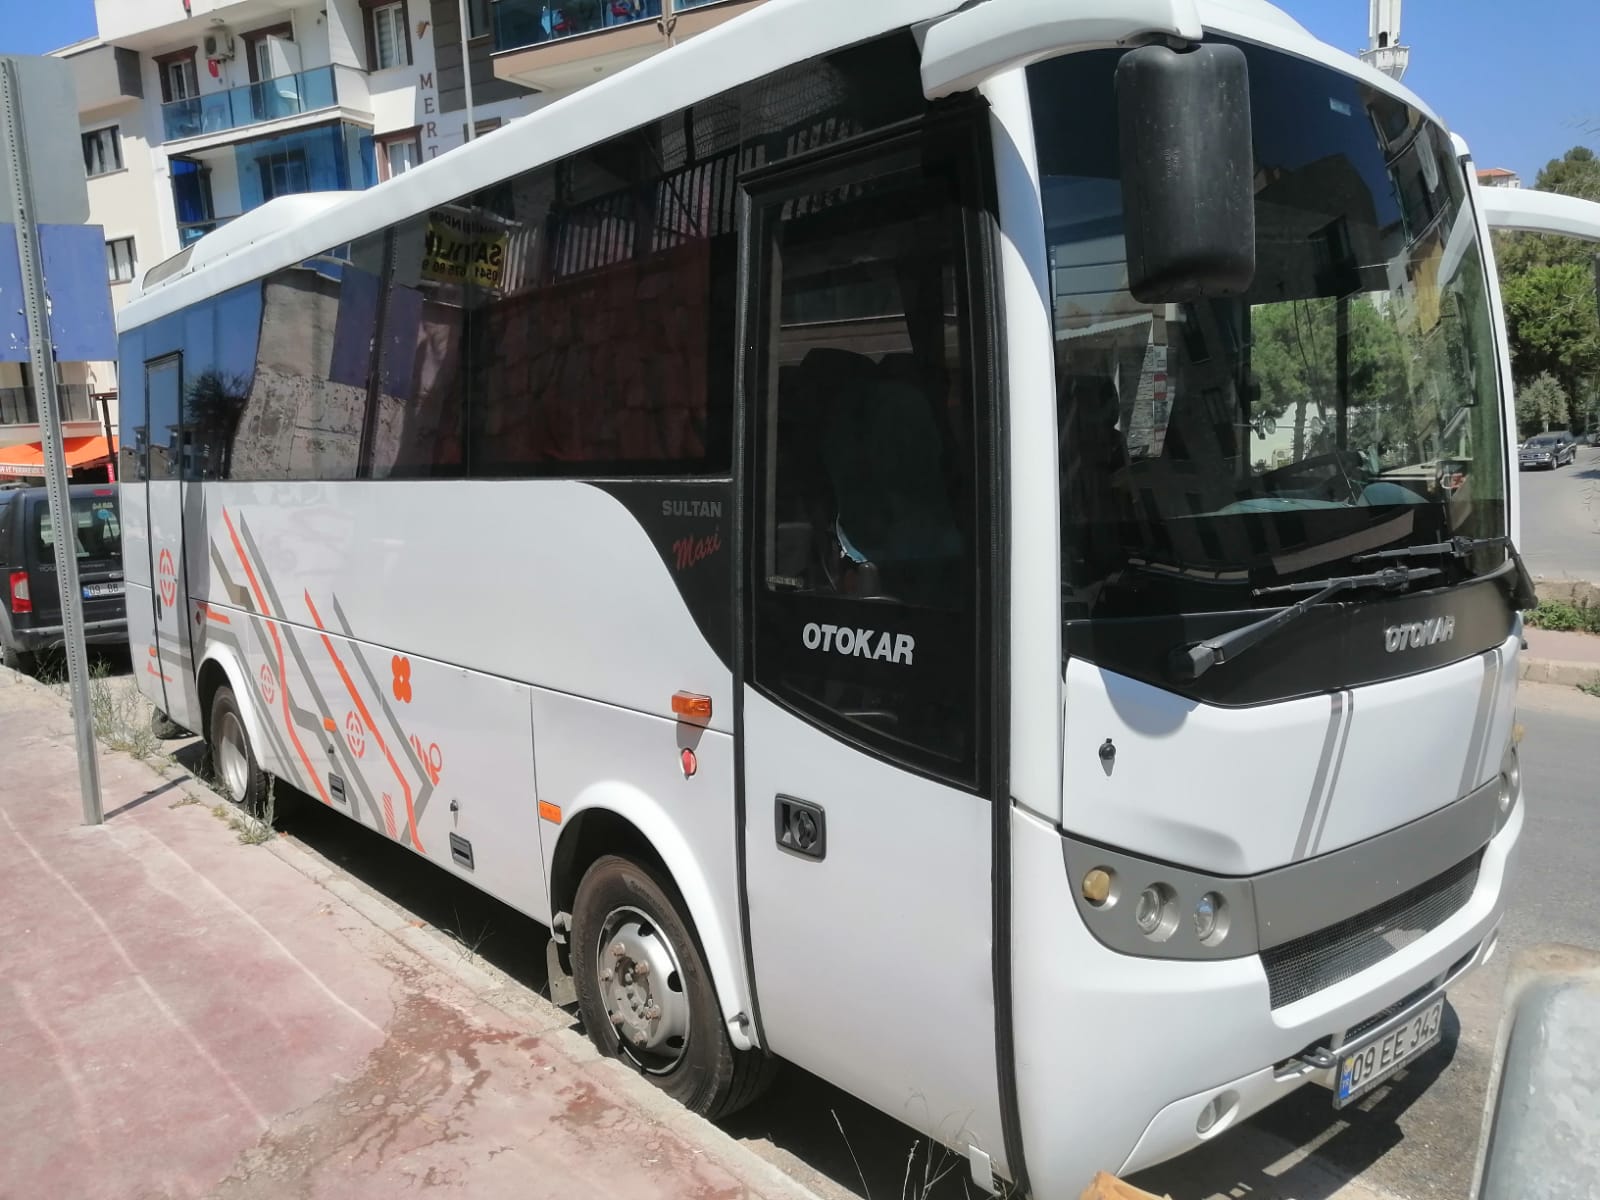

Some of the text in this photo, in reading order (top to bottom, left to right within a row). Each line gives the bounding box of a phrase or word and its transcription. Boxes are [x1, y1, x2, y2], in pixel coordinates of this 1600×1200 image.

[420, 72, 439, 159] MERT
[662, 500, 722, 518] SULTAN
[672, 527, 722, 571] Maxi
[802, 622, 915, 665] OTOKAR
[1385, 615, 1455, 653] OTOKAR
[1351, 1046, 1376, 1086] 09
[1380, 1026, 1407, 1068] EE
[1410, 1004, 1440, 1048] 343
